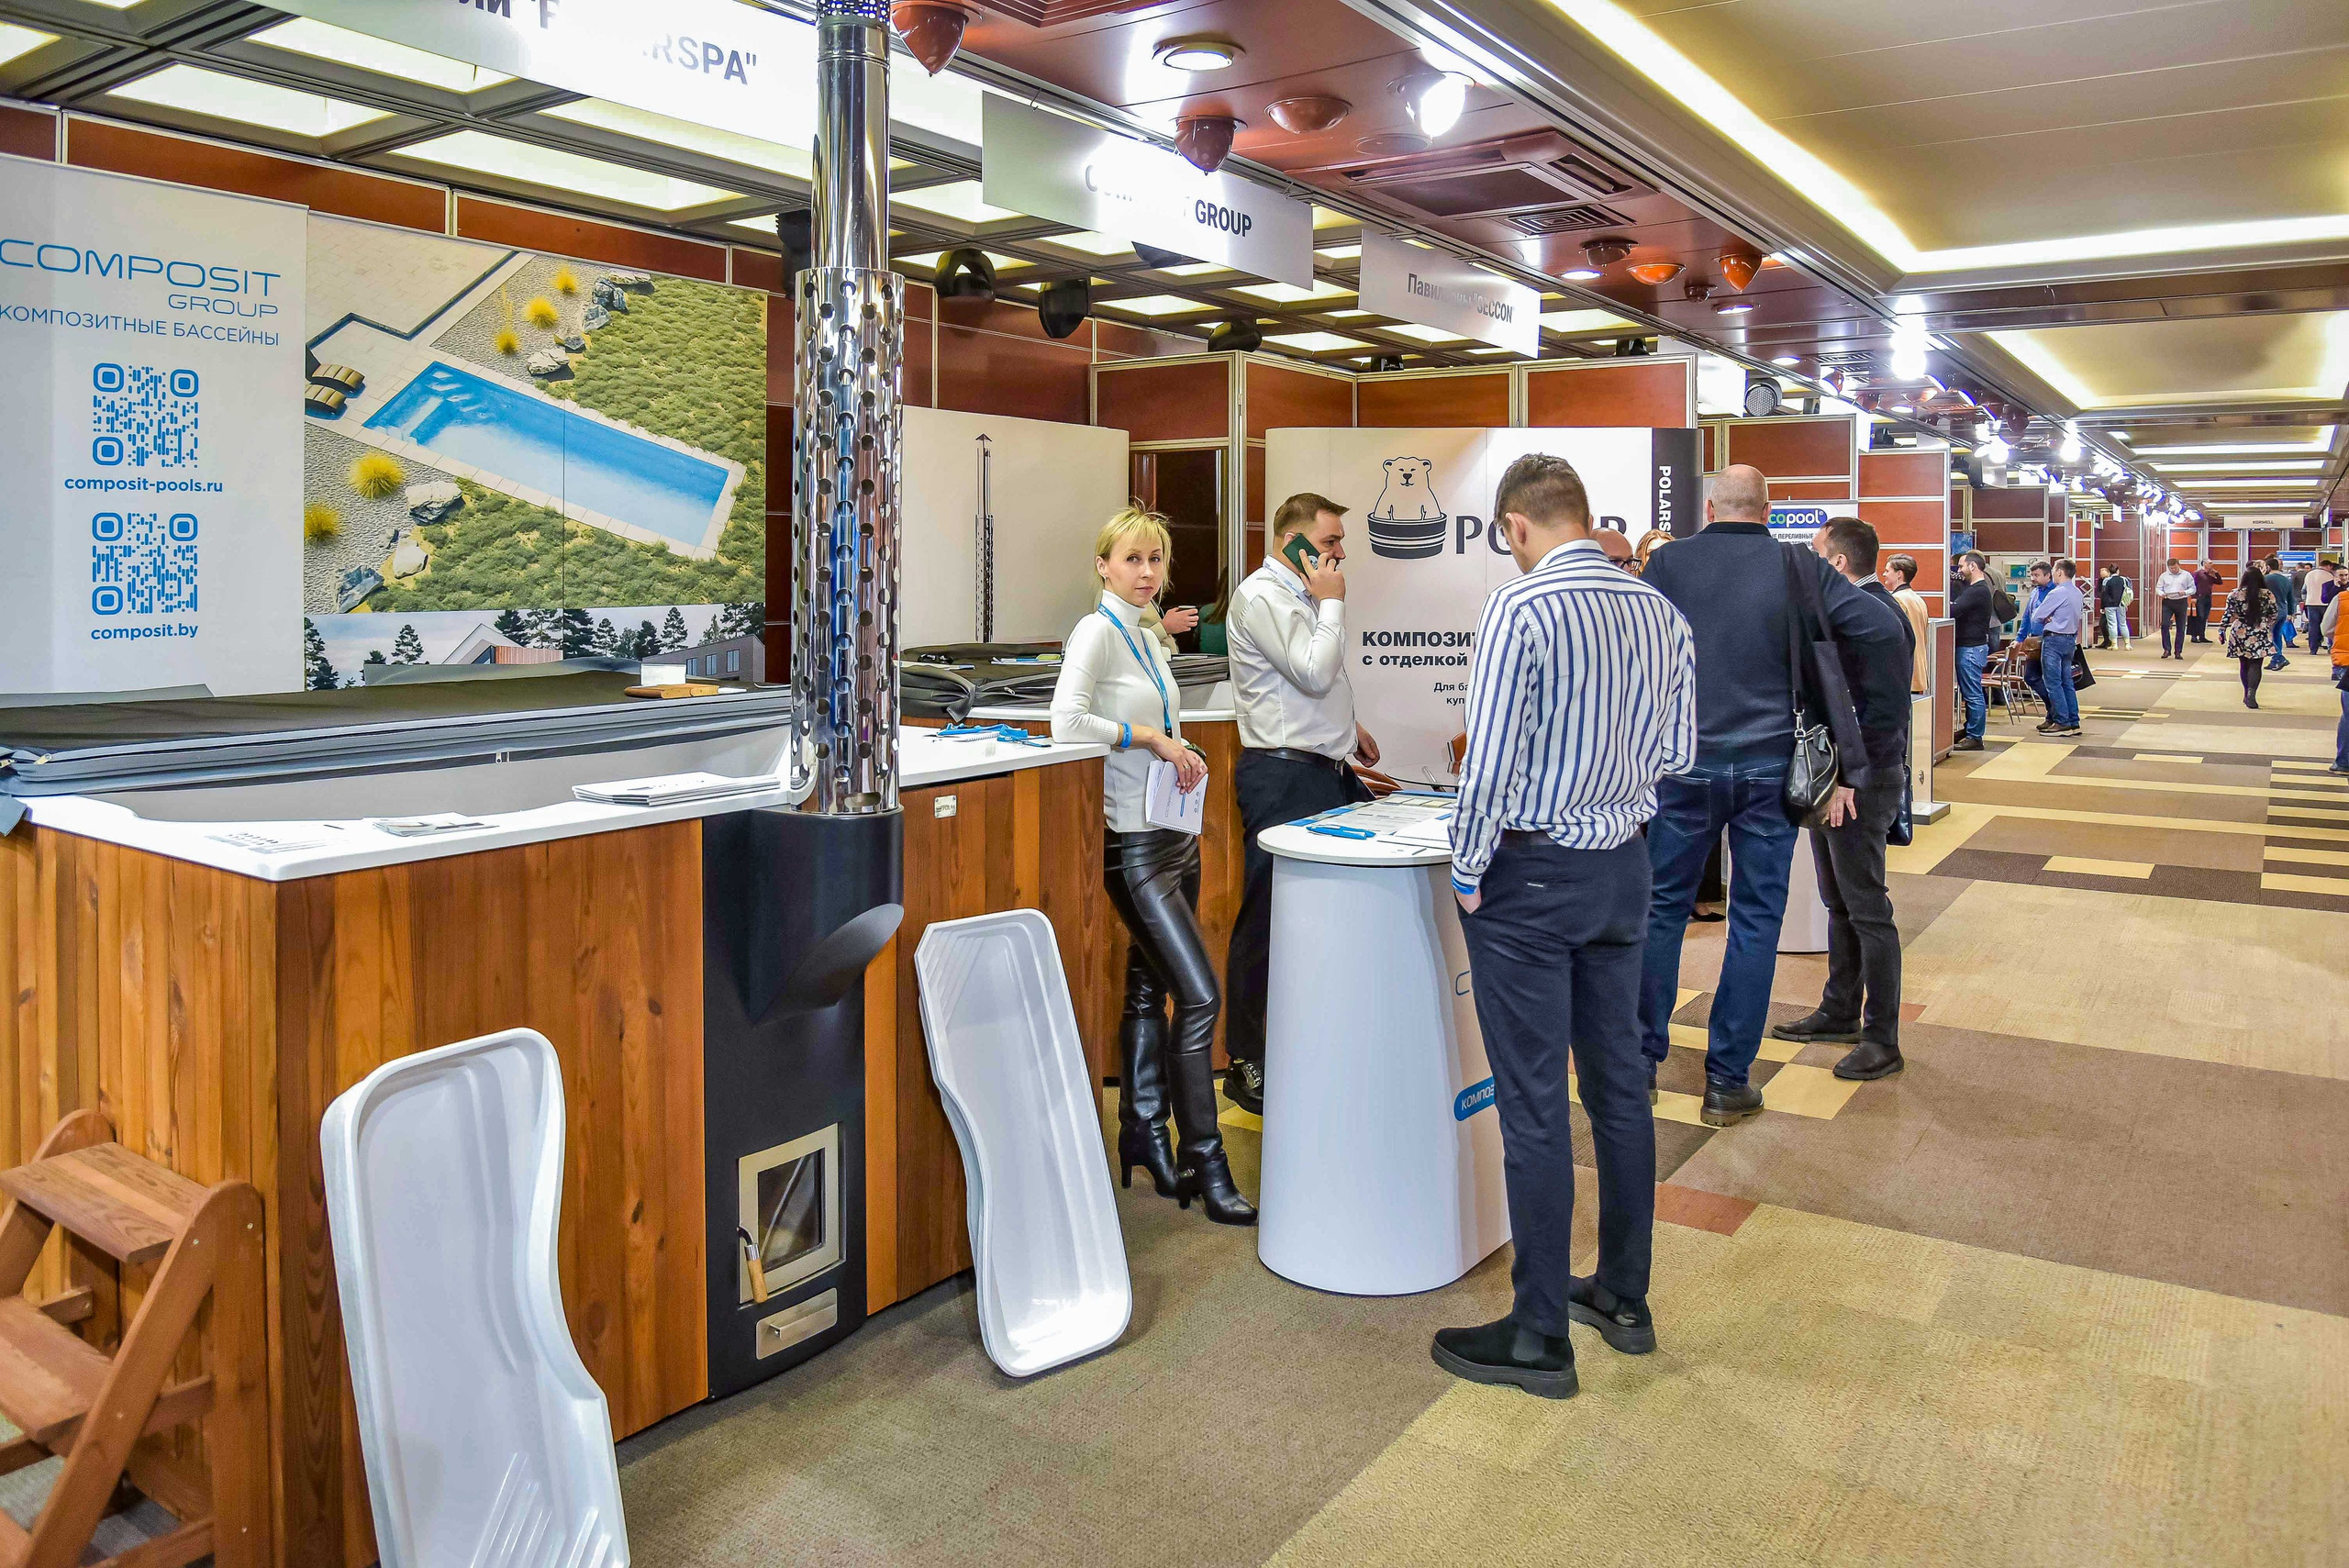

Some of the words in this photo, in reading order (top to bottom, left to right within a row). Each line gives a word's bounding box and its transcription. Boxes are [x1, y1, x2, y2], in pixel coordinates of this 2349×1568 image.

[1195, 199, 1252, 238] GROUP
[0, 239, 281, 296] COMPOSIT
[168, 294, 278, 317] GROUP
[0, 304, 167, 336] КОМПОЗИТНЫЕ
[173, 322, 279, 346] БАССЕЙНЫ
[63, 477, 223, 494] composit-pools.ru
[1658, 465, 1672, 535] POLARS
[91, 623, 198, 640] composit.by
[1363, 631, 1475, 647] КОМПОЗИ
[1362, 655, 1373, 666] с
[1379, 652, 1468, 668] отделкой
[1433, 682, 1455, 693] Для
